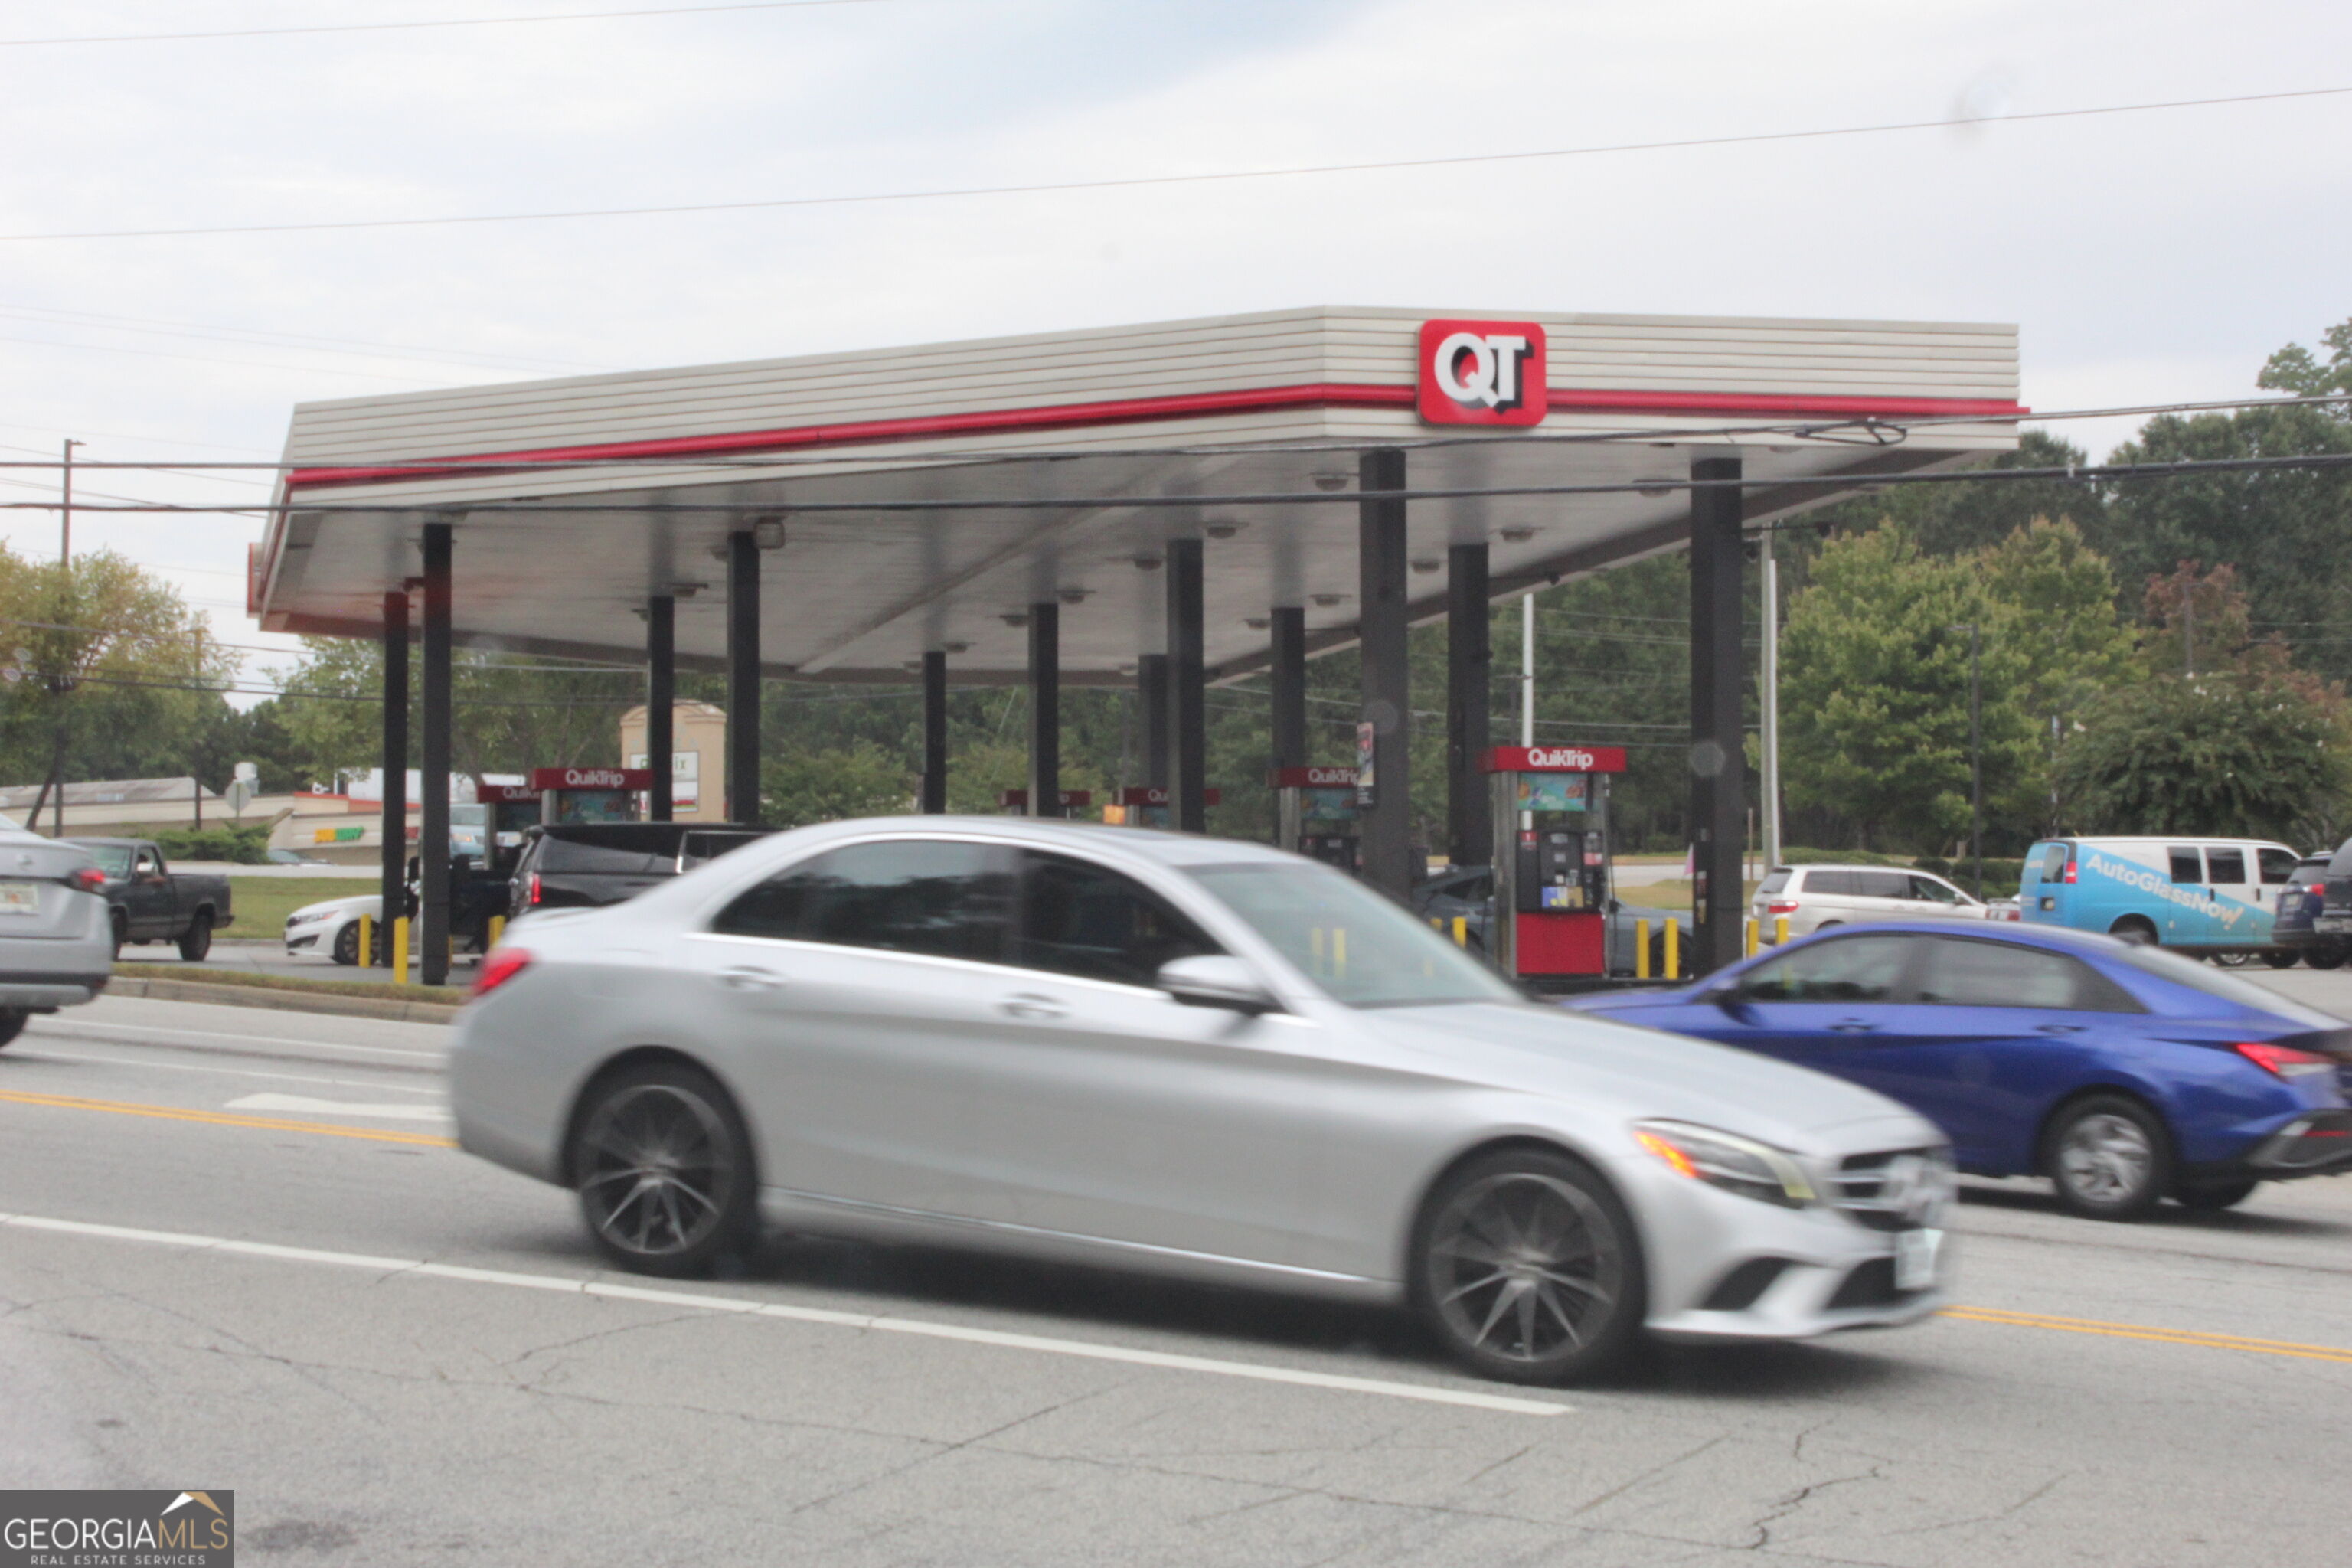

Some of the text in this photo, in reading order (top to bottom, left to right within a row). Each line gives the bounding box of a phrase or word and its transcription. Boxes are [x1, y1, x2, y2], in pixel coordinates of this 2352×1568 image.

[1434, 332, 1530, 410] QT
[1527, 748, 1593, 771] QuikTrip
[565, 769, 625, 788] QuikTrip
